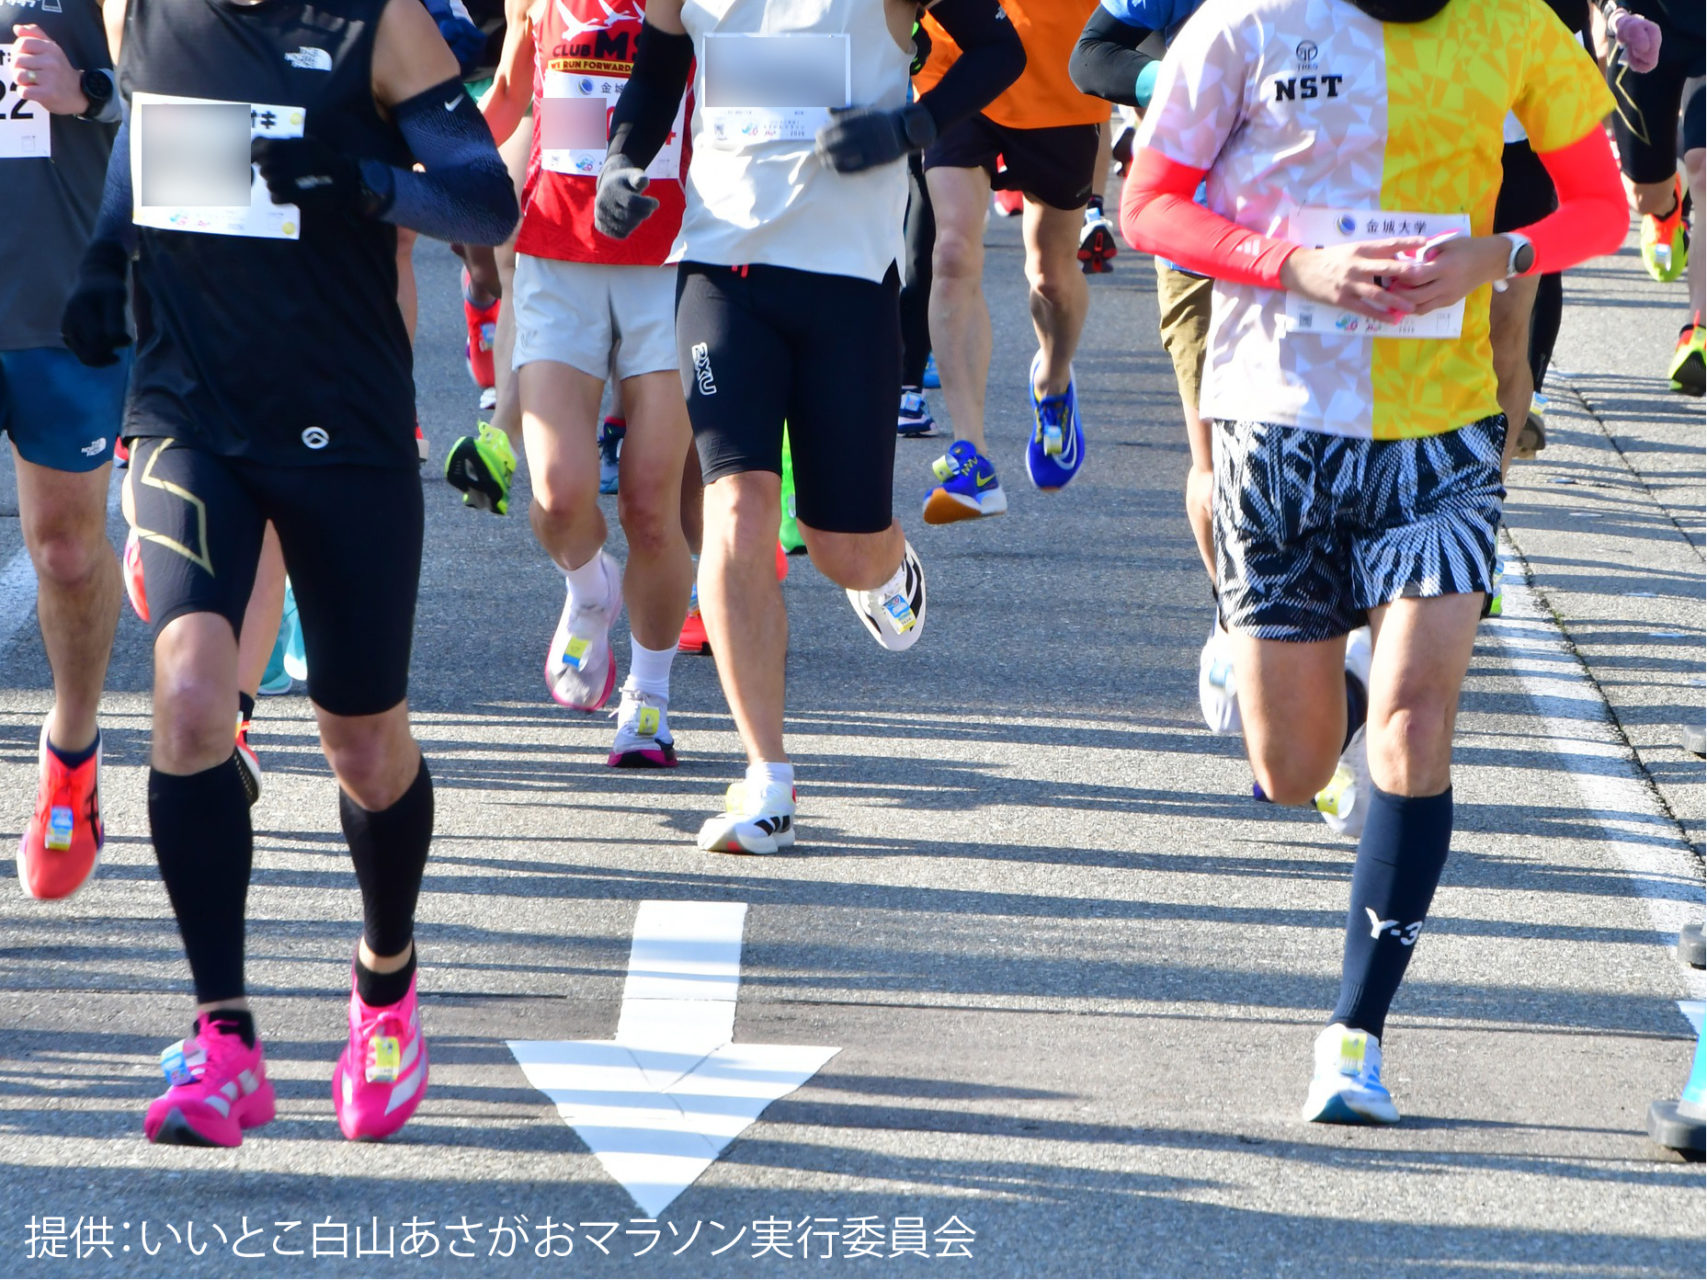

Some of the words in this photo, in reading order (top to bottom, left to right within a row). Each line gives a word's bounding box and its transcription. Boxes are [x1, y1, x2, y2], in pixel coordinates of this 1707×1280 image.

[553, 44, 591, 58] CLUB
[563, 60, 581, 70] RUN
[583, 61, 632, 72] FORWARD
[1274, 73, 1343, 101] NST
[1366, 220, 1427, 235] 金城大学
[692, 341, 717, 395] 2XU
[1365, 906, 1423, 946] Y-3
